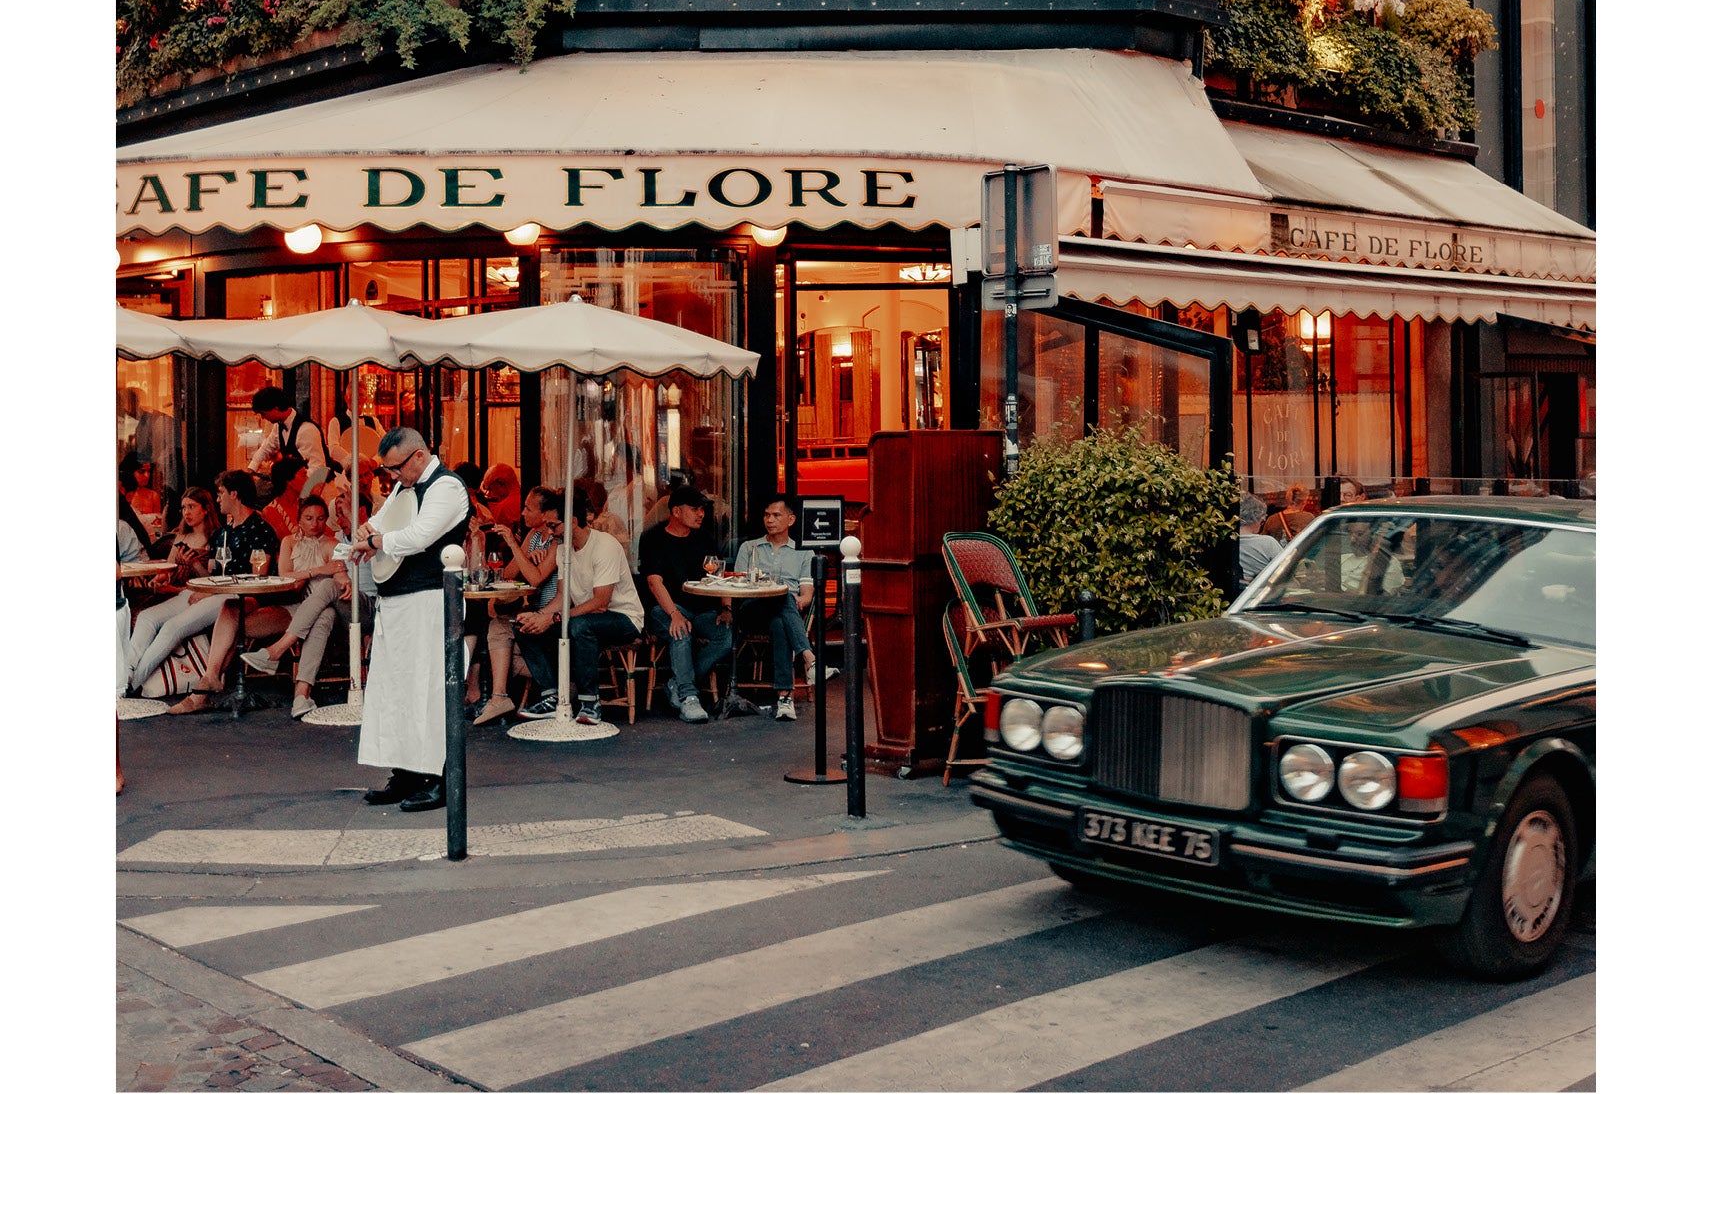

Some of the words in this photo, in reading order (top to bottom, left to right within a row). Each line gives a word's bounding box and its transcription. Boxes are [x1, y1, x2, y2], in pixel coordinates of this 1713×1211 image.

[117, 168, 309, 215] AFE
[361, 167, 506, 208] DE
[561, 166, 918, 209] FLORE
[1290, 227, 1357, 253] CAFE
[1367, 235, 1399, 256] DE
[1408, 239, 1484, 264] FLORE
[1084, 813, 1127, 843] 373
[1181, 831, 1213, 860] 75
